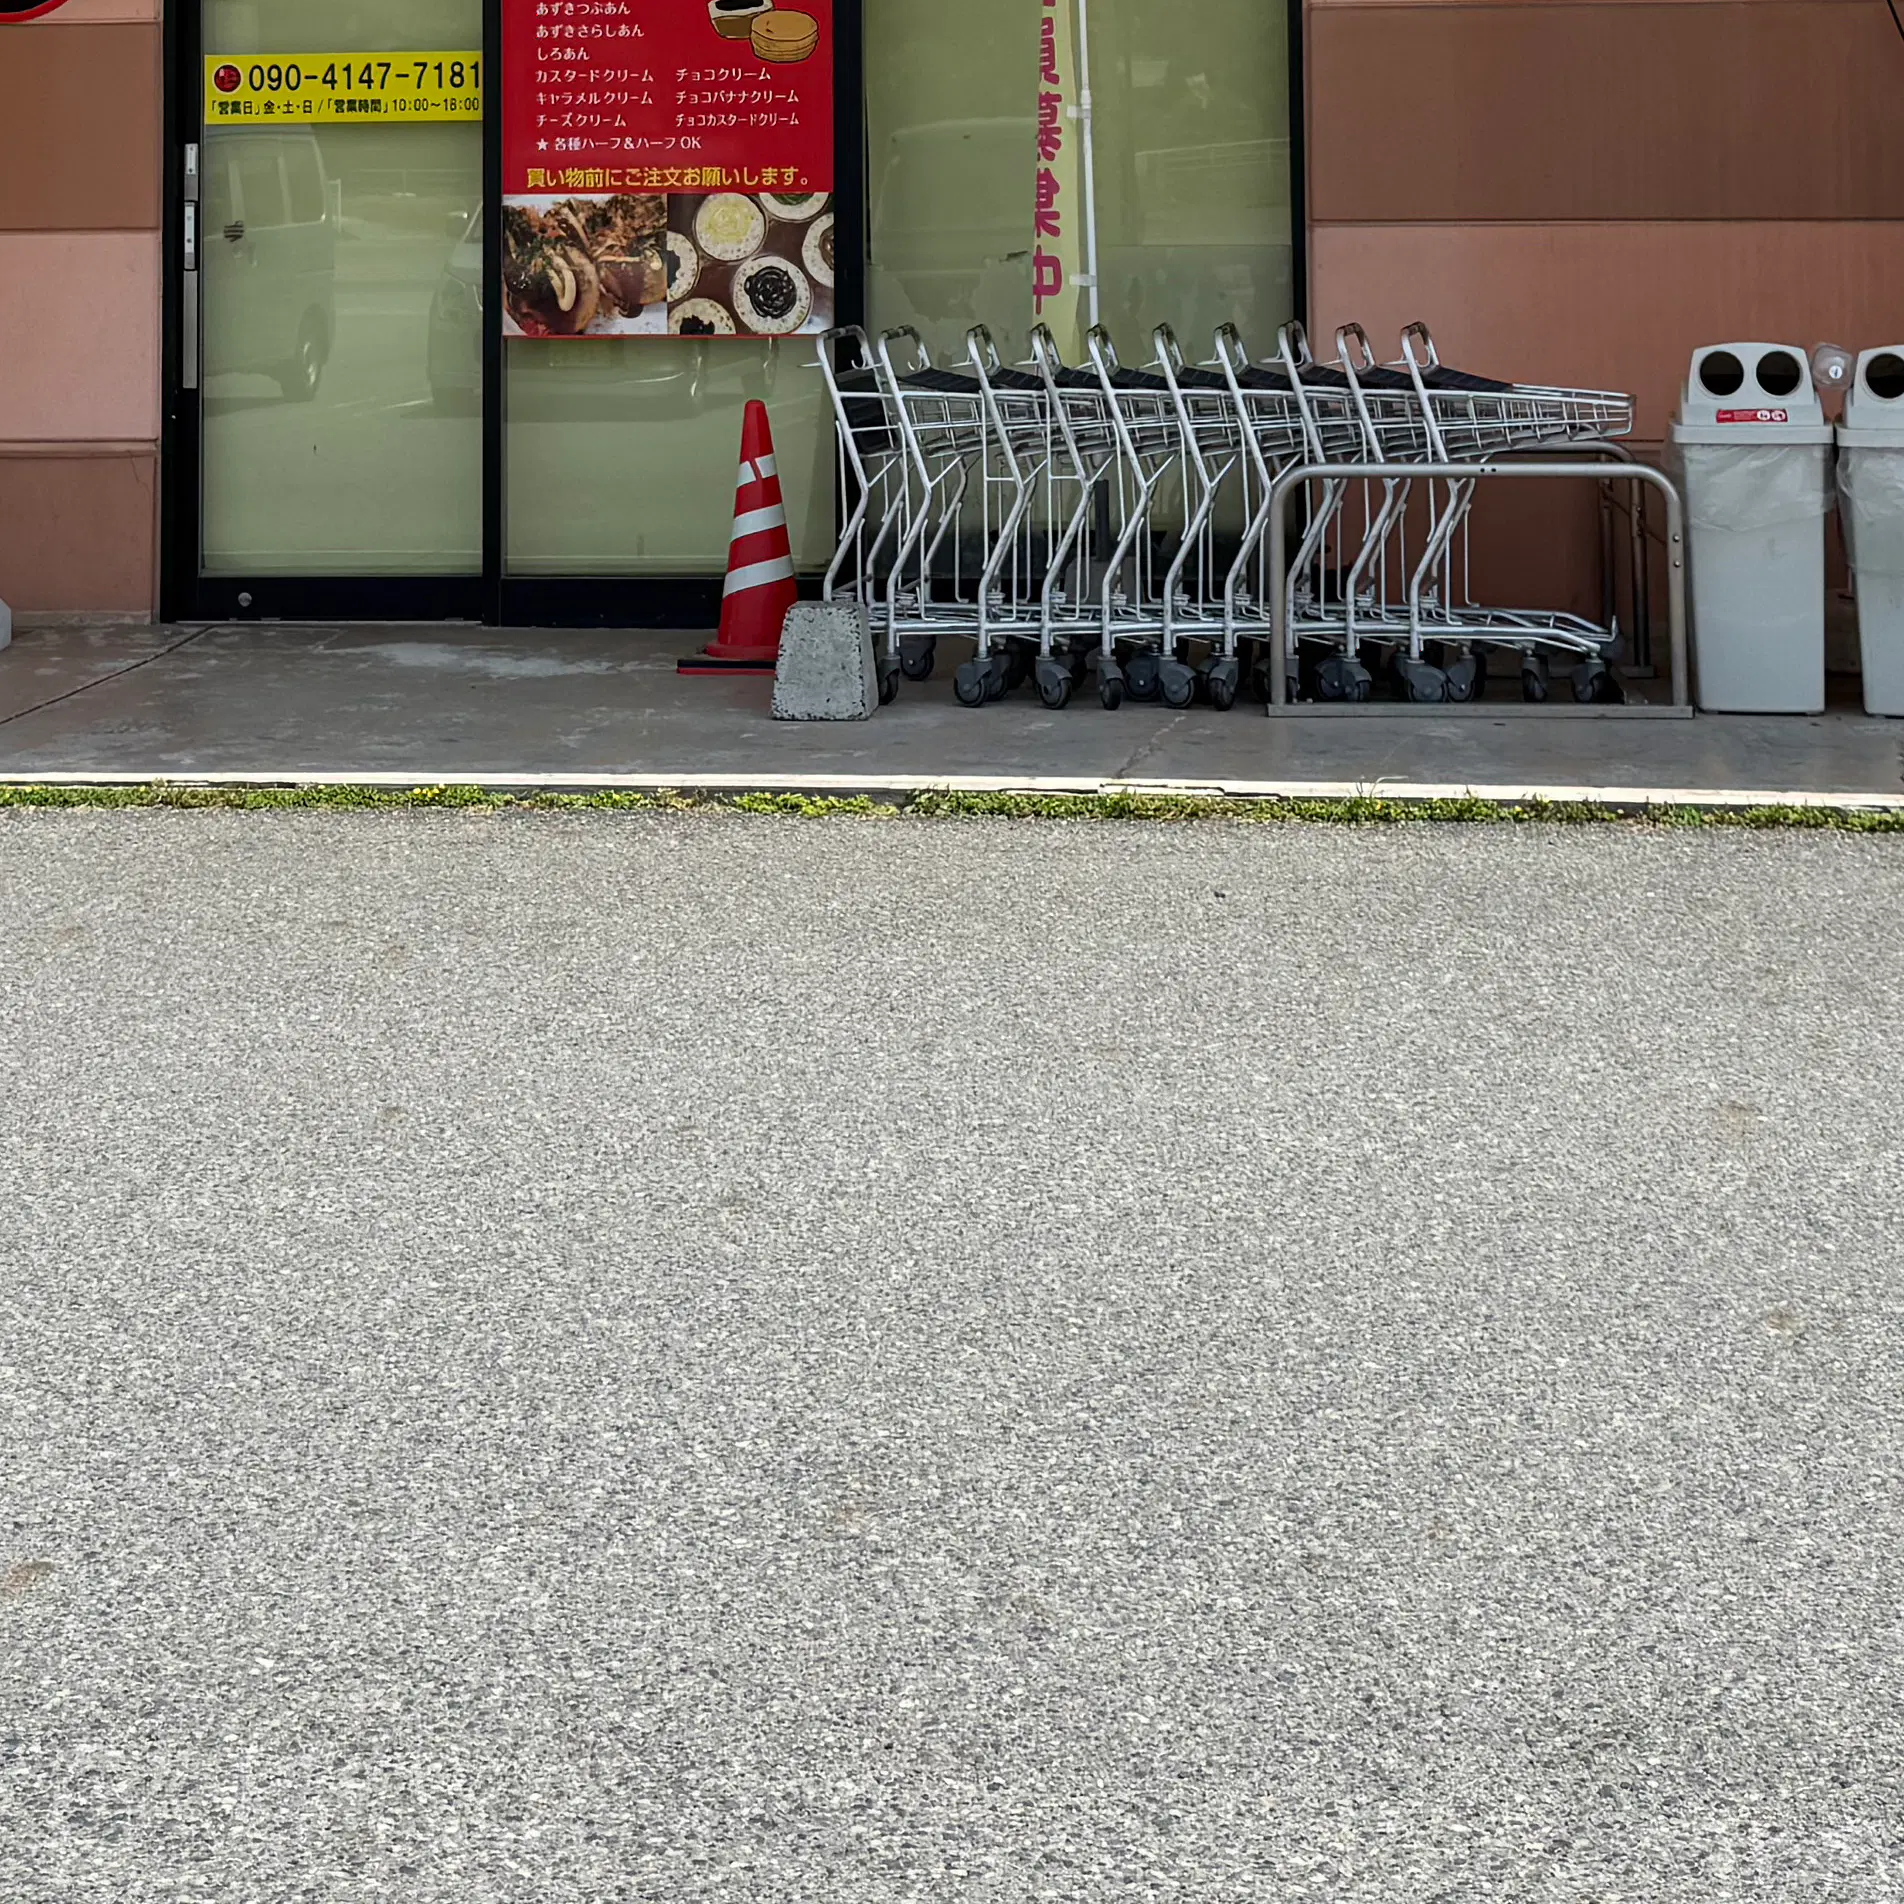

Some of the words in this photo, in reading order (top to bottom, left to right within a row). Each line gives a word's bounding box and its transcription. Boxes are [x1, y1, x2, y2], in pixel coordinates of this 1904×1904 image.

[536, 1, 631, 16] あずきつぶあん
[536, 23, 645, 39] あずきさらしあん
[537, 46, 590, 61] しろあん
[248, 61, 481, 92] 090-4147-7181
[536, 68, 654, 83] カスタードクリーム
[676, 67, 771, 82] チョコクリーム
[536, 91, 653, 106] キャラメルクリーム
[675, 89, 799, 105] チョコバナナクリーム
[536, 113, 627, 128] チーズクリーム
[675, 112, 800, 128] チョコカスタードクリーム
[526, 167, 809, 189] 買い物前にご注文お願いします。
